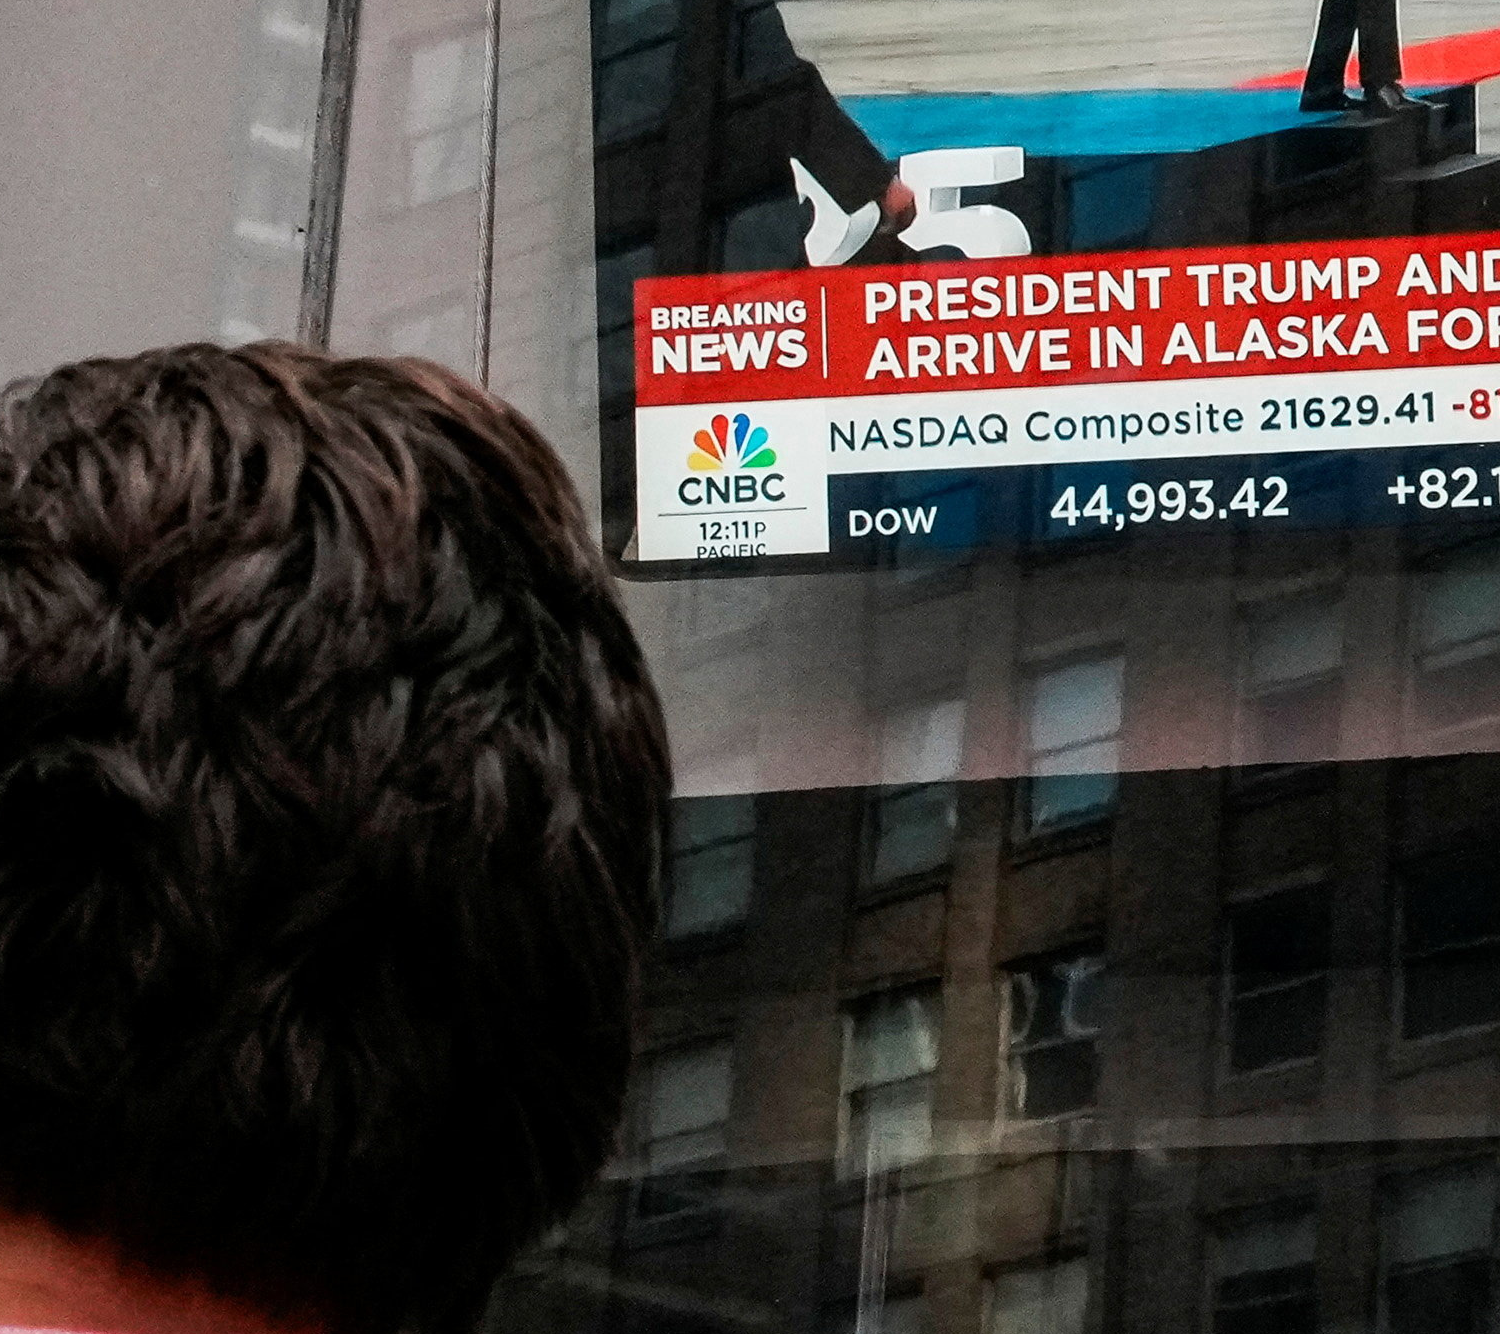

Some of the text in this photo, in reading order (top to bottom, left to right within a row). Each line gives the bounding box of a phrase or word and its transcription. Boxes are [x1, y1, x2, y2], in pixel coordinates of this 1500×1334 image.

[651, 301, 807, 329] BREAKING
[864, 268, 1170, 324] PRESIDENT
[1187, 256, 1381, 308] TRUMP
[651, 328, 808, 374] NEWS
[864, 329, 1070, 380] ARRIVE
[1090, 325, 1143, 368] IN
[1161, 311, 1389, 365] ALASKA
[830, 416, 1008, 451] NASDAQ
[1026, 402, 1243, 443] Composite
[1261, 391, 1435, 430] 21629.41
[677, 473, 785, 505] CNBC
[849, 507, 936, 536] DOW
[1050, 476, 1289, 531] 44,993.42
[696, 544, 766, 558] PACIFIC
